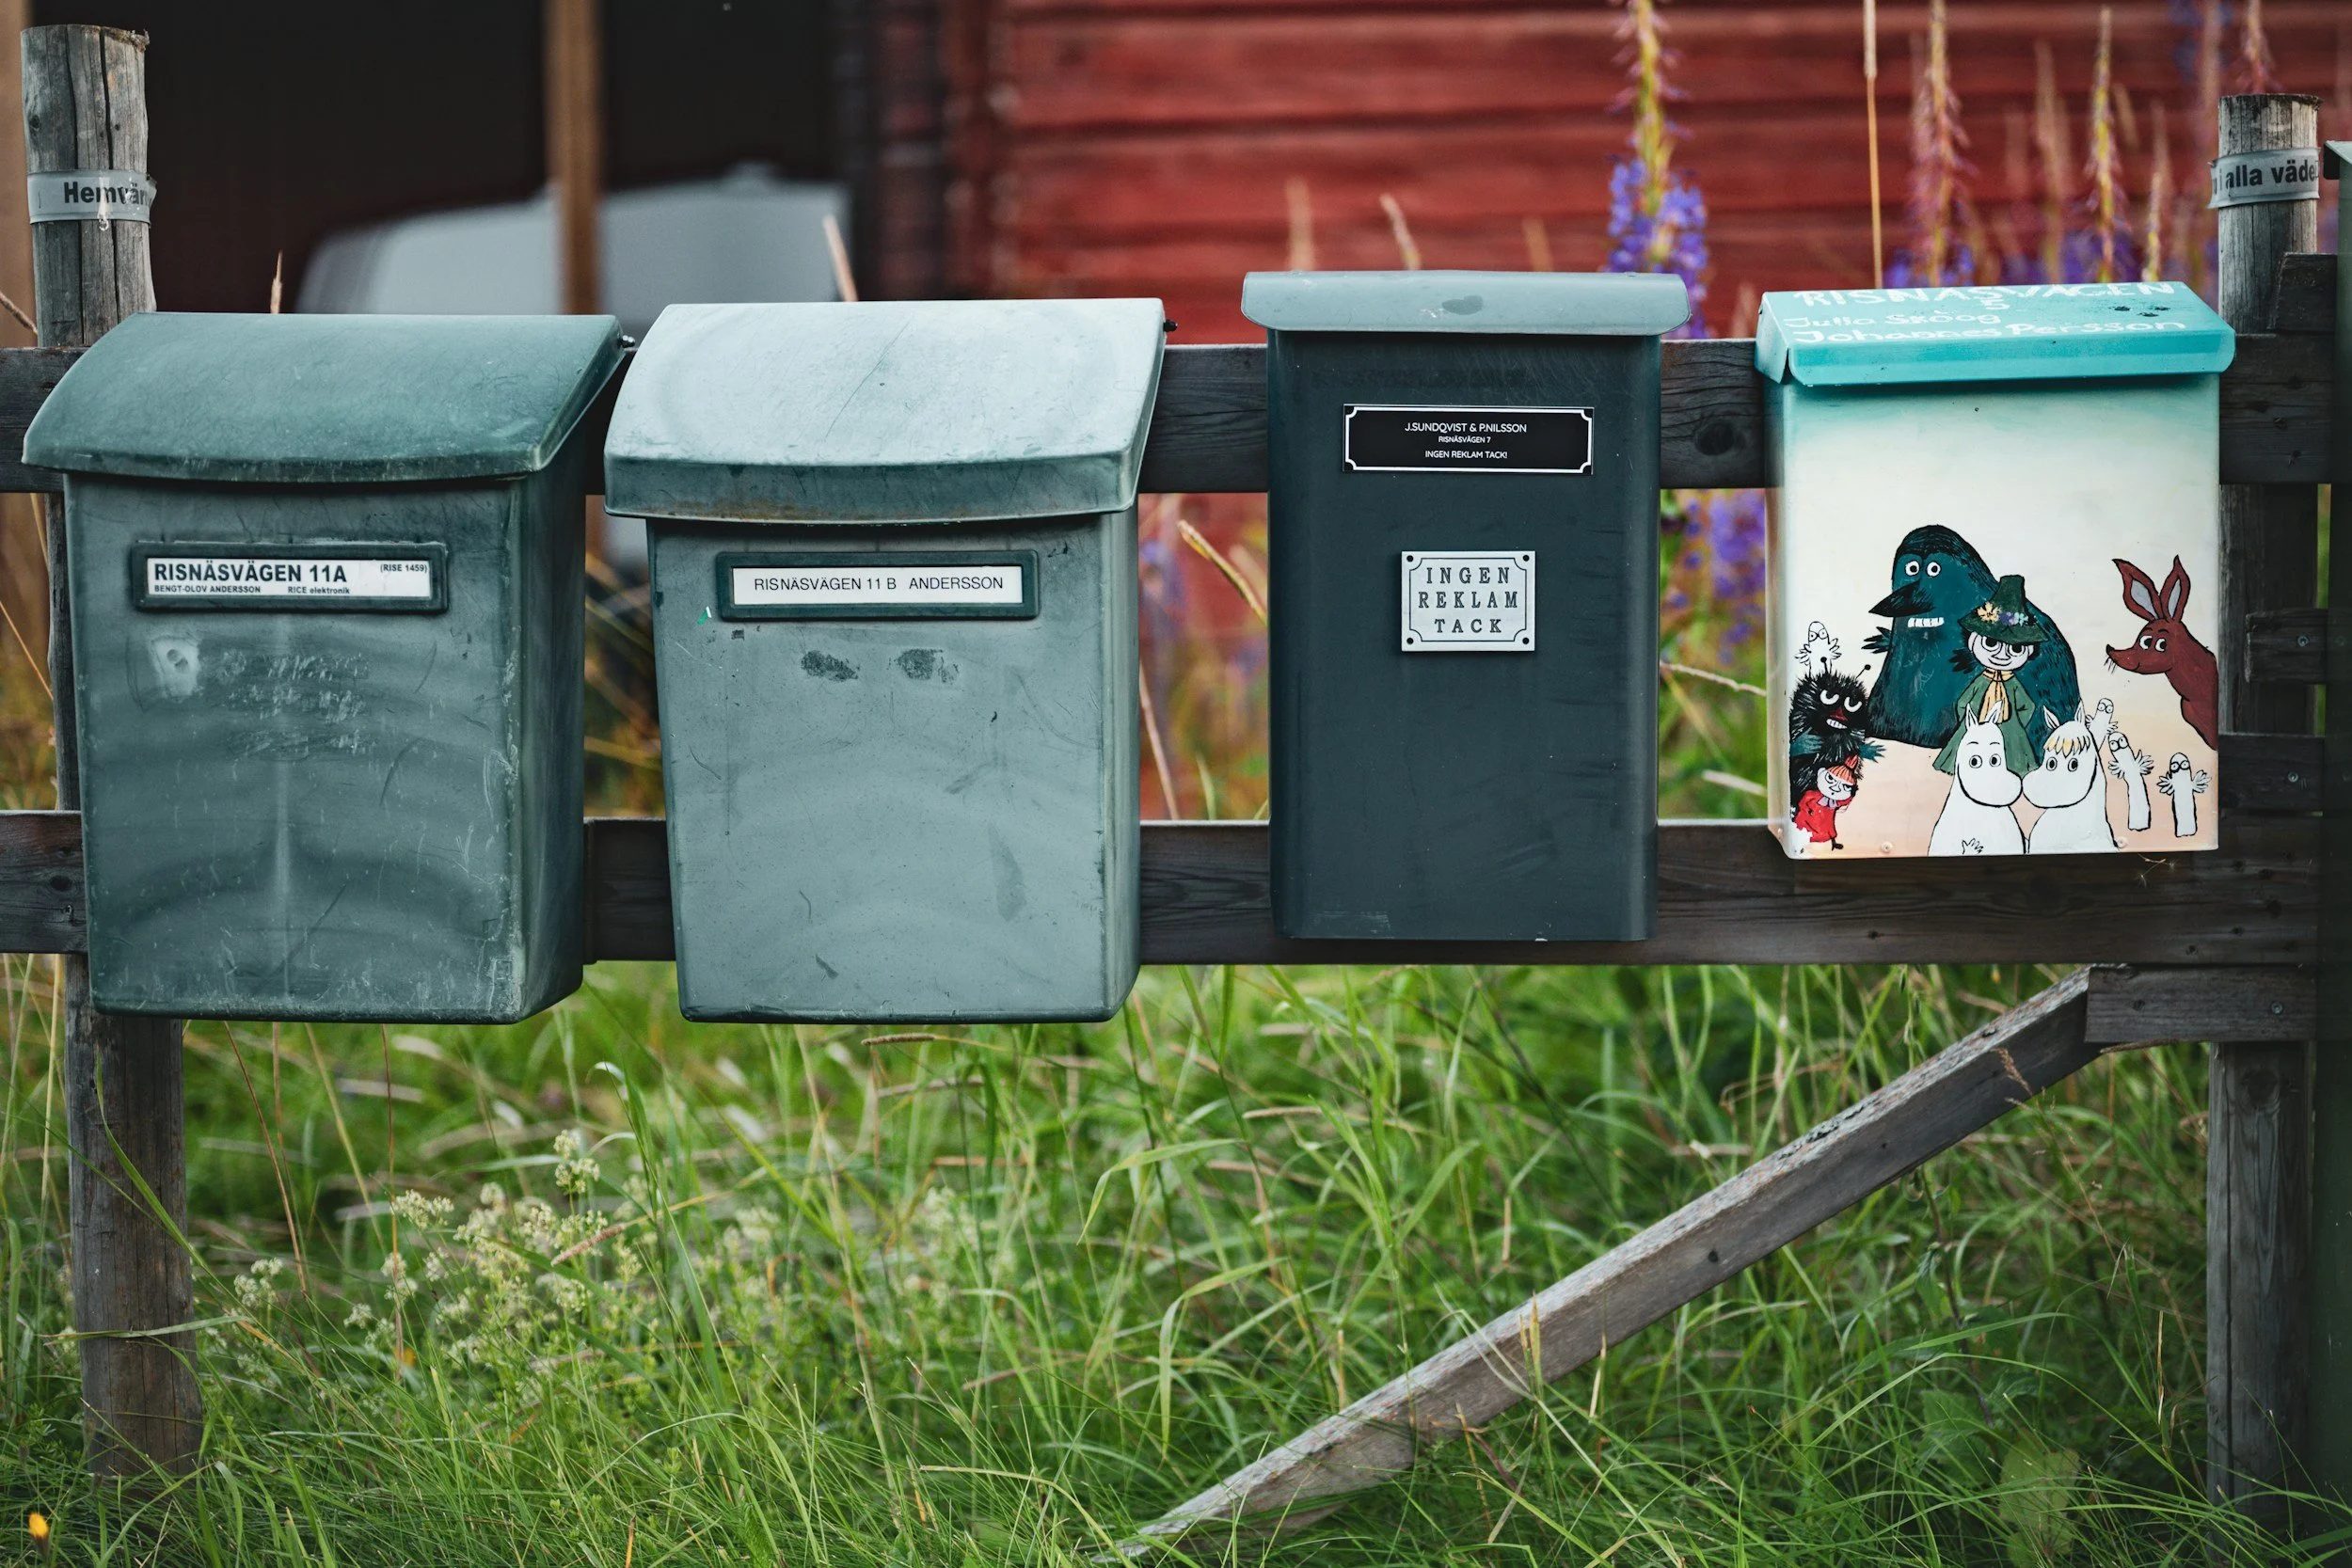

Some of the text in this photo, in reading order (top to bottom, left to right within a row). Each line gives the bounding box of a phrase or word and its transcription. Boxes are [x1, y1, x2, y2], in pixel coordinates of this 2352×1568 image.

[2225, 164, 2264, 189] alla
[2271, 159, 2318, 184] väde
[1792, 322, 2186, 343] Johannes Persson
[1405, 422, 1527, 433] J.SUNDQVIST & P.NILSSON
[1451, 451, 1484, 459] REKLAM
[1485, 451, 1508, 459] TACK!
[154, 560, 428, 582] RISNÄSVÄGEN 11A (RISE 1459)
[1426, 567, 1510, 584] INGEN
[210, 585, 261, 594] ANDERSSON
[288, 586, 307, 594] RICE
[755, 577, 1003, 591] RISNÄSVÄGEN 11 B ANDERSSON
[1418, 591, 1518, 609] REKLAM
[1434, 618, 1502, 633] TACK
